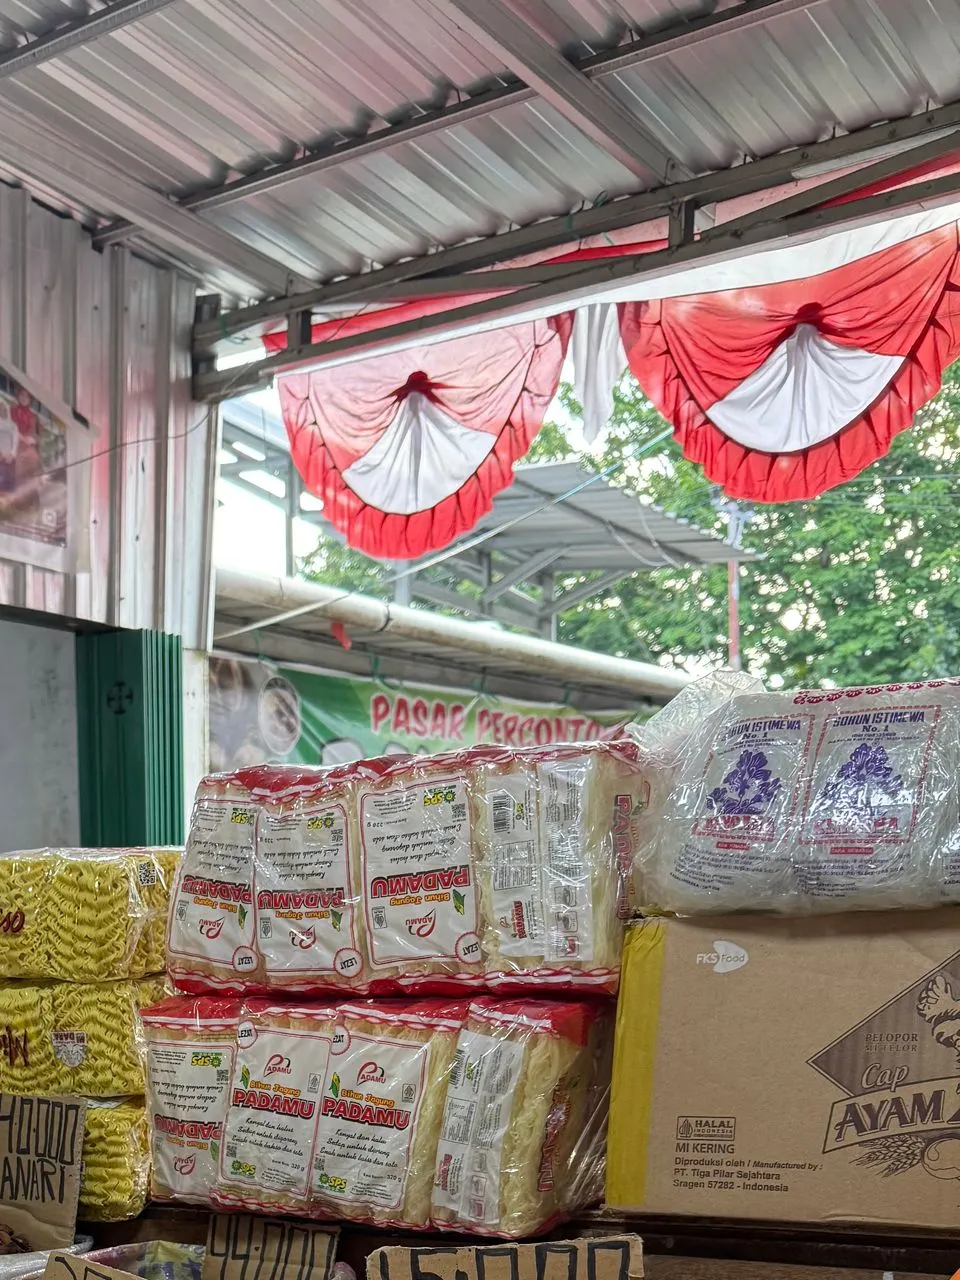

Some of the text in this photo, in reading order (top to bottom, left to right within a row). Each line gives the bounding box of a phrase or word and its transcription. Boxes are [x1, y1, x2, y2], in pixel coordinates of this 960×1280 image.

[371, 695, 600, 745] PASAR PERCONTO
[873, 712, 925, 722] ISTIMEWA
[752, 720, 801, 732] ISTIMEWA
[424, 792, 445, 806] SPS
[371, 865, 470, 898] PADAMU
[182, 875, 252, 904] PADAMU
[257, 887, 344, 909] PADAMU
[390, 893, 450, 906] Bihun Jagung
[305, 911, 330, 919] Bihun
[237, 957, 253, 966] LEZAT
[340, 957, 357, 969] LEZAT
[696, 952, 745, 964] FKS Food
[238, 1029, 253, 1038] EZAT
[865, 1033, 918, 1042] PELOPOR
[191, 1056, 210, 1066] SPS
[862, 1062, 909, 1092] Cap
[250, 1080, 301, 1097] Bihun Jagung
[232, 1088, 315, 1119] PADAMU
[340, 1089, 394, 1108] Bihun Jagung
[322, 1096, 411, 1131] PADAMU
[834, 1089, 945, 1142] AYAM
[154, 1114, 222, 1140] PADAMU
[695, 1120, 733, 1128] HALAL
[676, 1143, 735, 1154] MI KERING
[675, 1157, 725, 1166] Diproduksi
[726, 1159, 745, 1167] oleh
[753, 1161, 806, 1169] Manufactured
[808, 1163, 818, 1171] by
[691, 1169, 710, 1178] Tiga
[713, 1170, 734, 1178] Pilar
[736, 1170, 780, 1180] Sejahtera
[328, 1176, 347, 1189] SPS
[673, 1180, 705, 1189] Sragen
[708, 1181, 734, 1189] 57282
[743, 1182, 788, 1191] Indonesia
